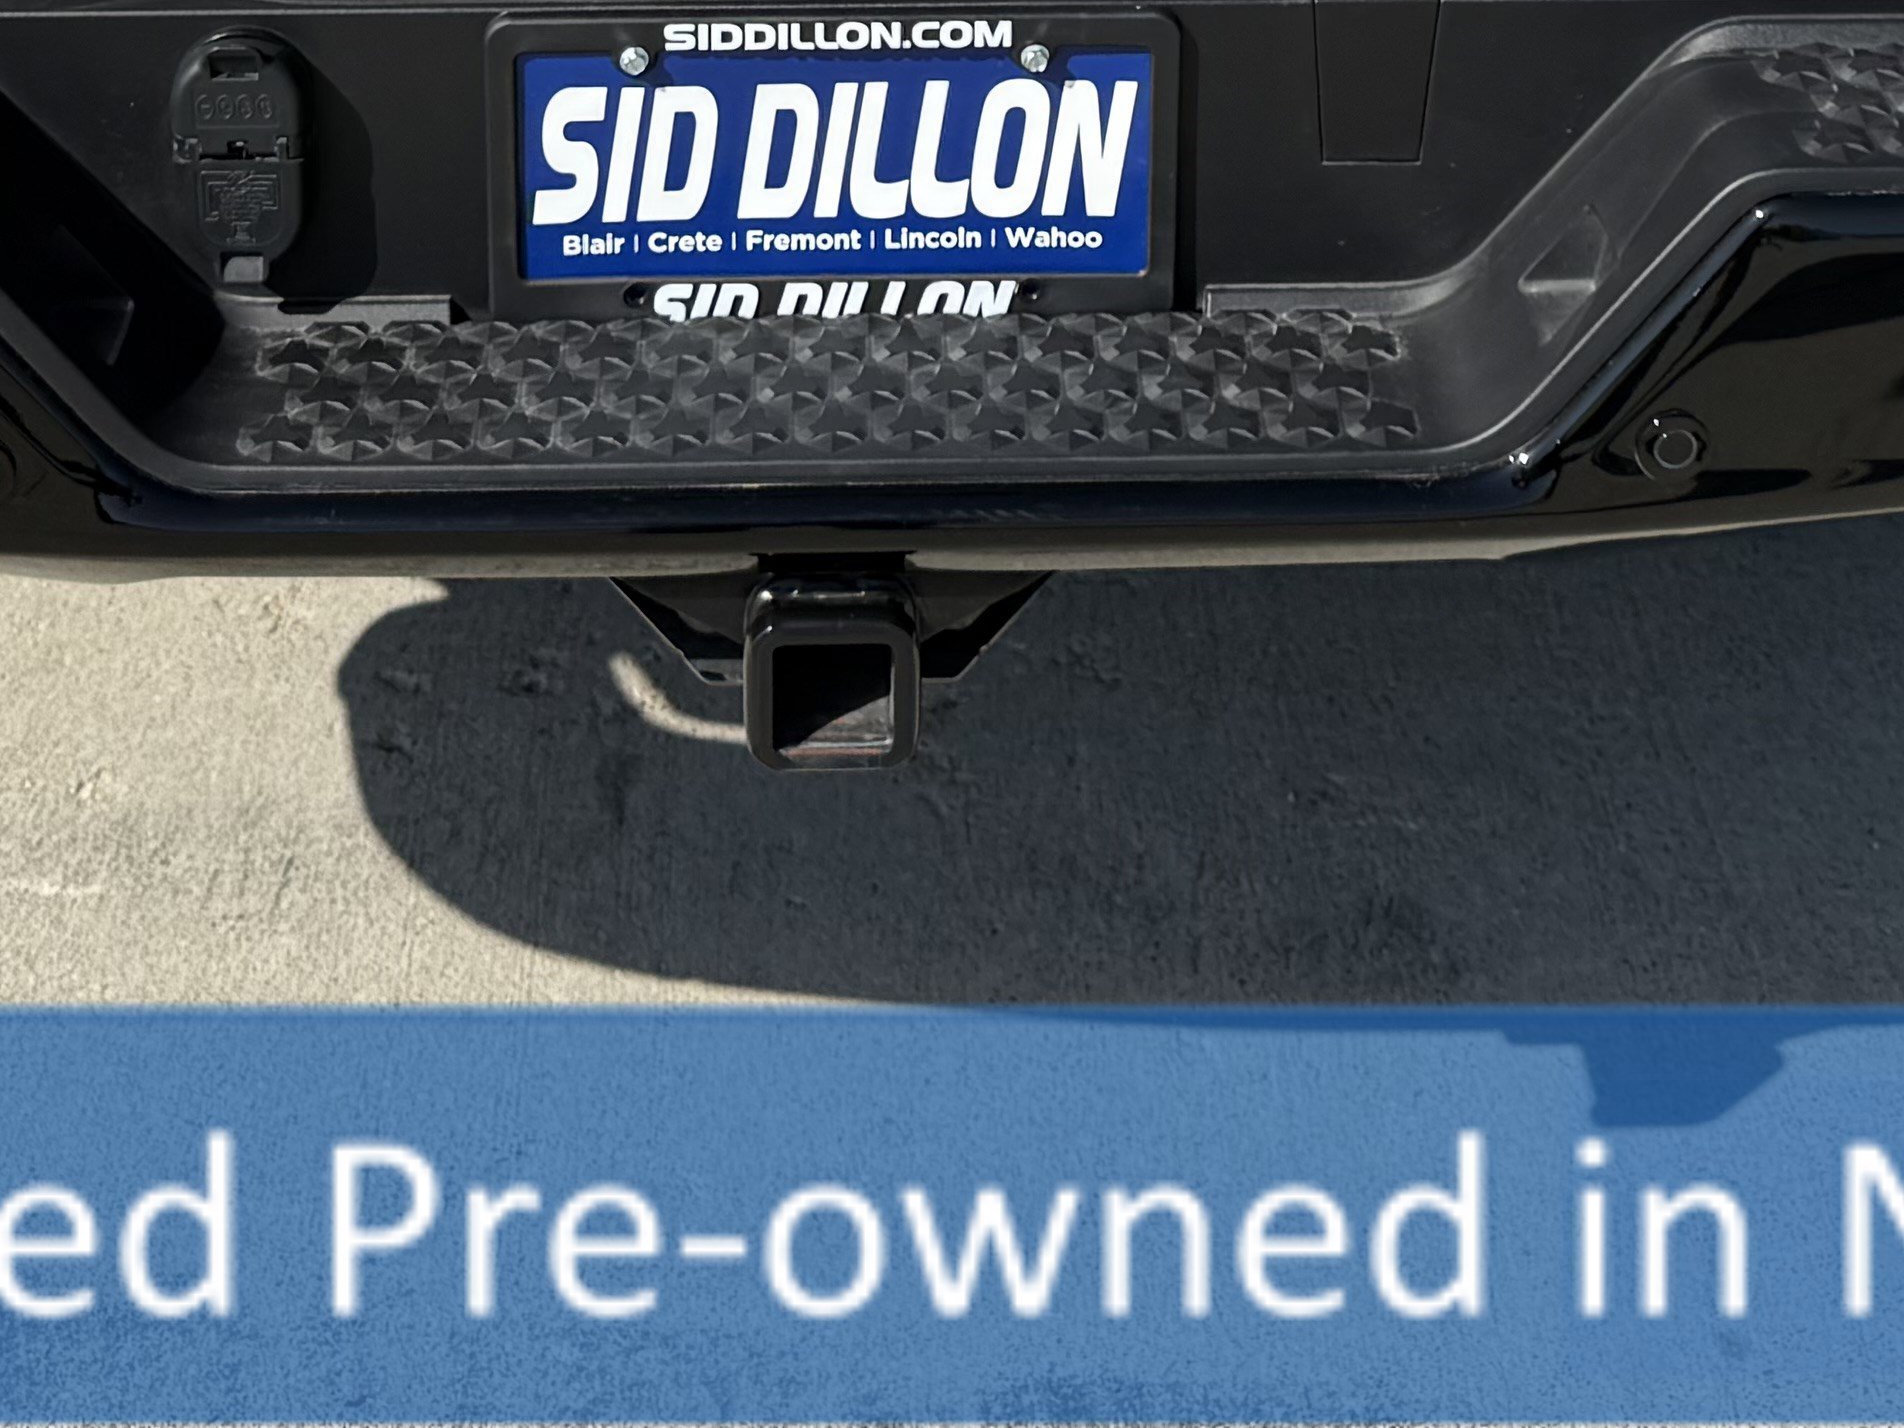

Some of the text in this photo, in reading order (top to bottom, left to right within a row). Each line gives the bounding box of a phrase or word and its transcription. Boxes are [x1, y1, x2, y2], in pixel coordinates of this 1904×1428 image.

[663, 20, 1014, 51] SIDDILLON.COM
[532, 79, 1139, 225] SID DILLON
[562, 227, 1104, 256] Blair Crete Fremont Lincoln Wahoo
